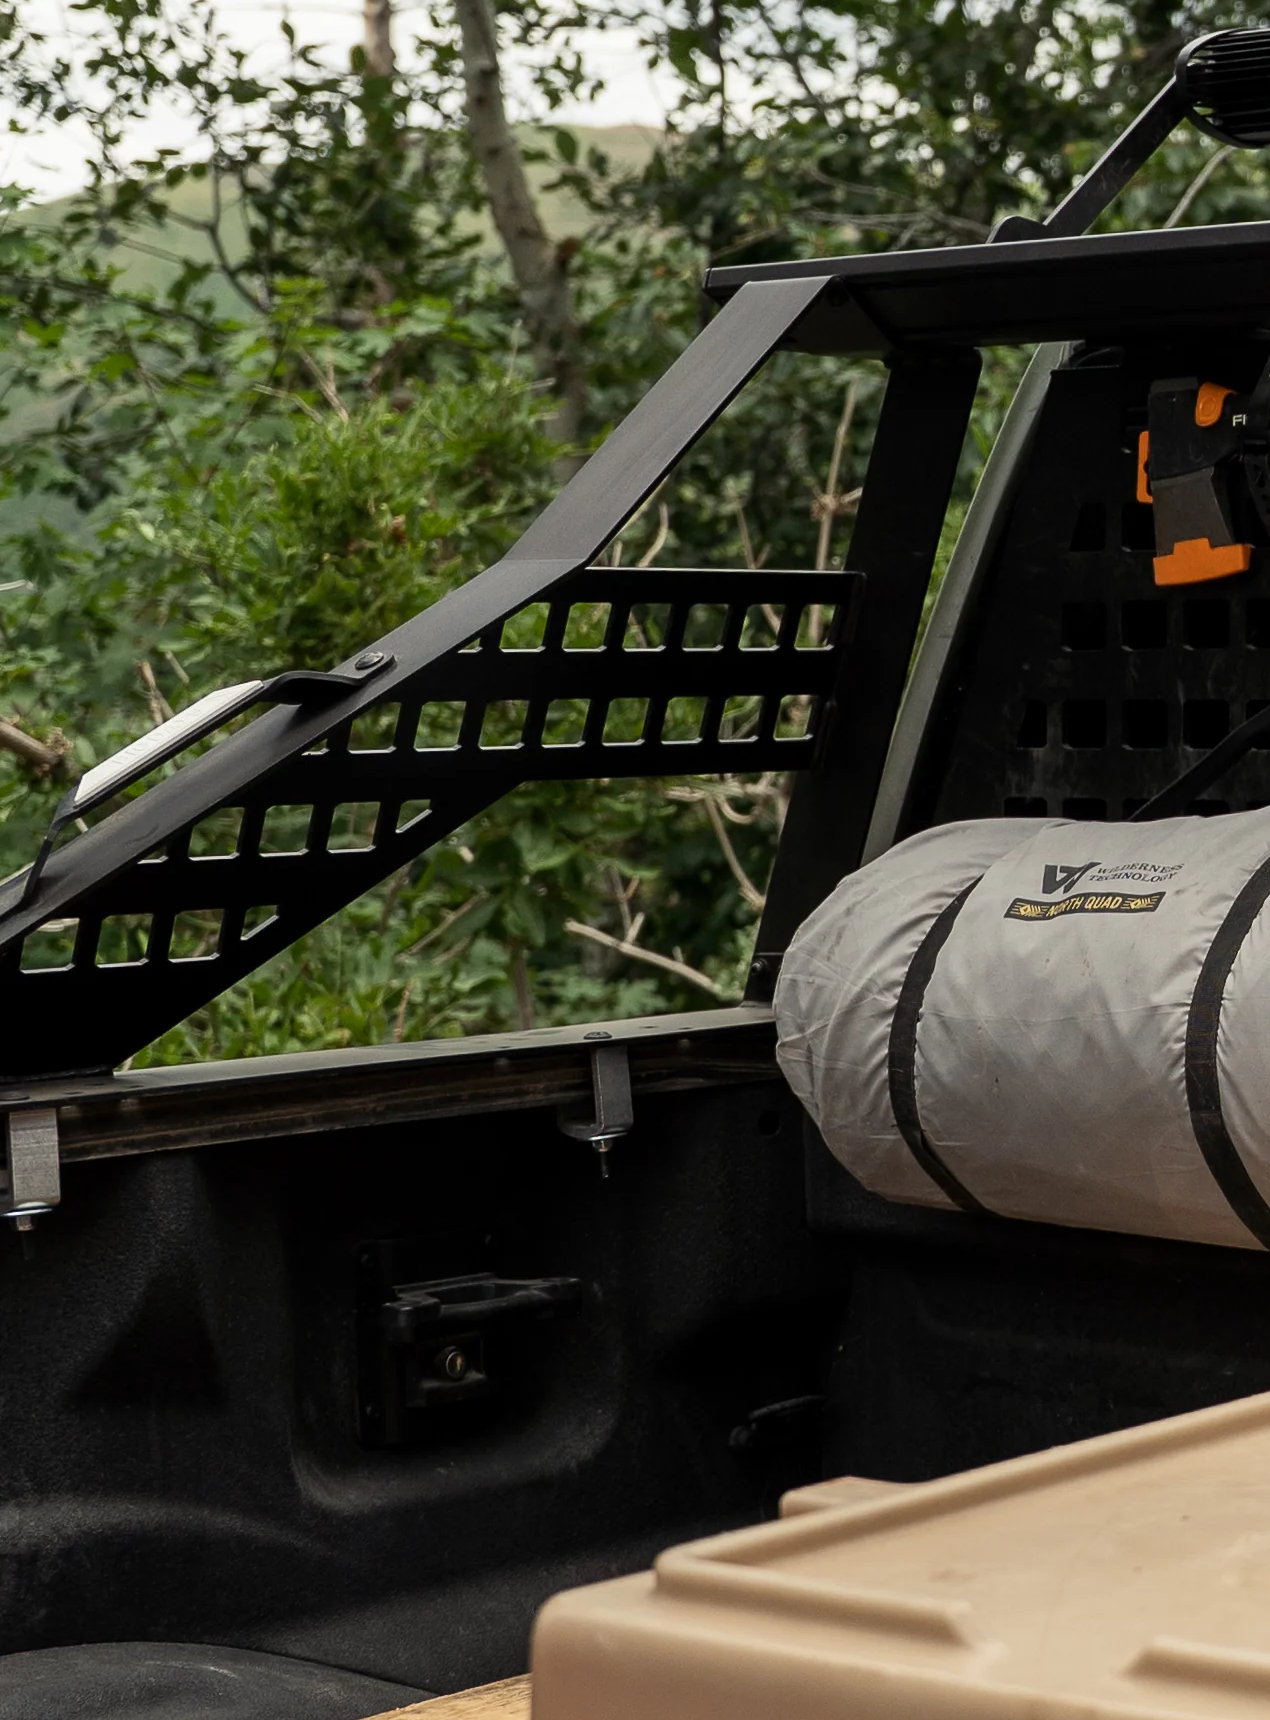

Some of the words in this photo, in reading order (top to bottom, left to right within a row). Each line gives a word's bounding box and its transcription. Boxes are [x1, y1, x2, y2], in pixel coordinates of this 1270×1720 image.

[1097, 862, 1185, 875] WILDERNESS
[1088, 871, 1179, 883] TECHNOLOGY
[1045, 896, 1084, 917] NORTH
[1084, 895, 1123, 909] QUAD
